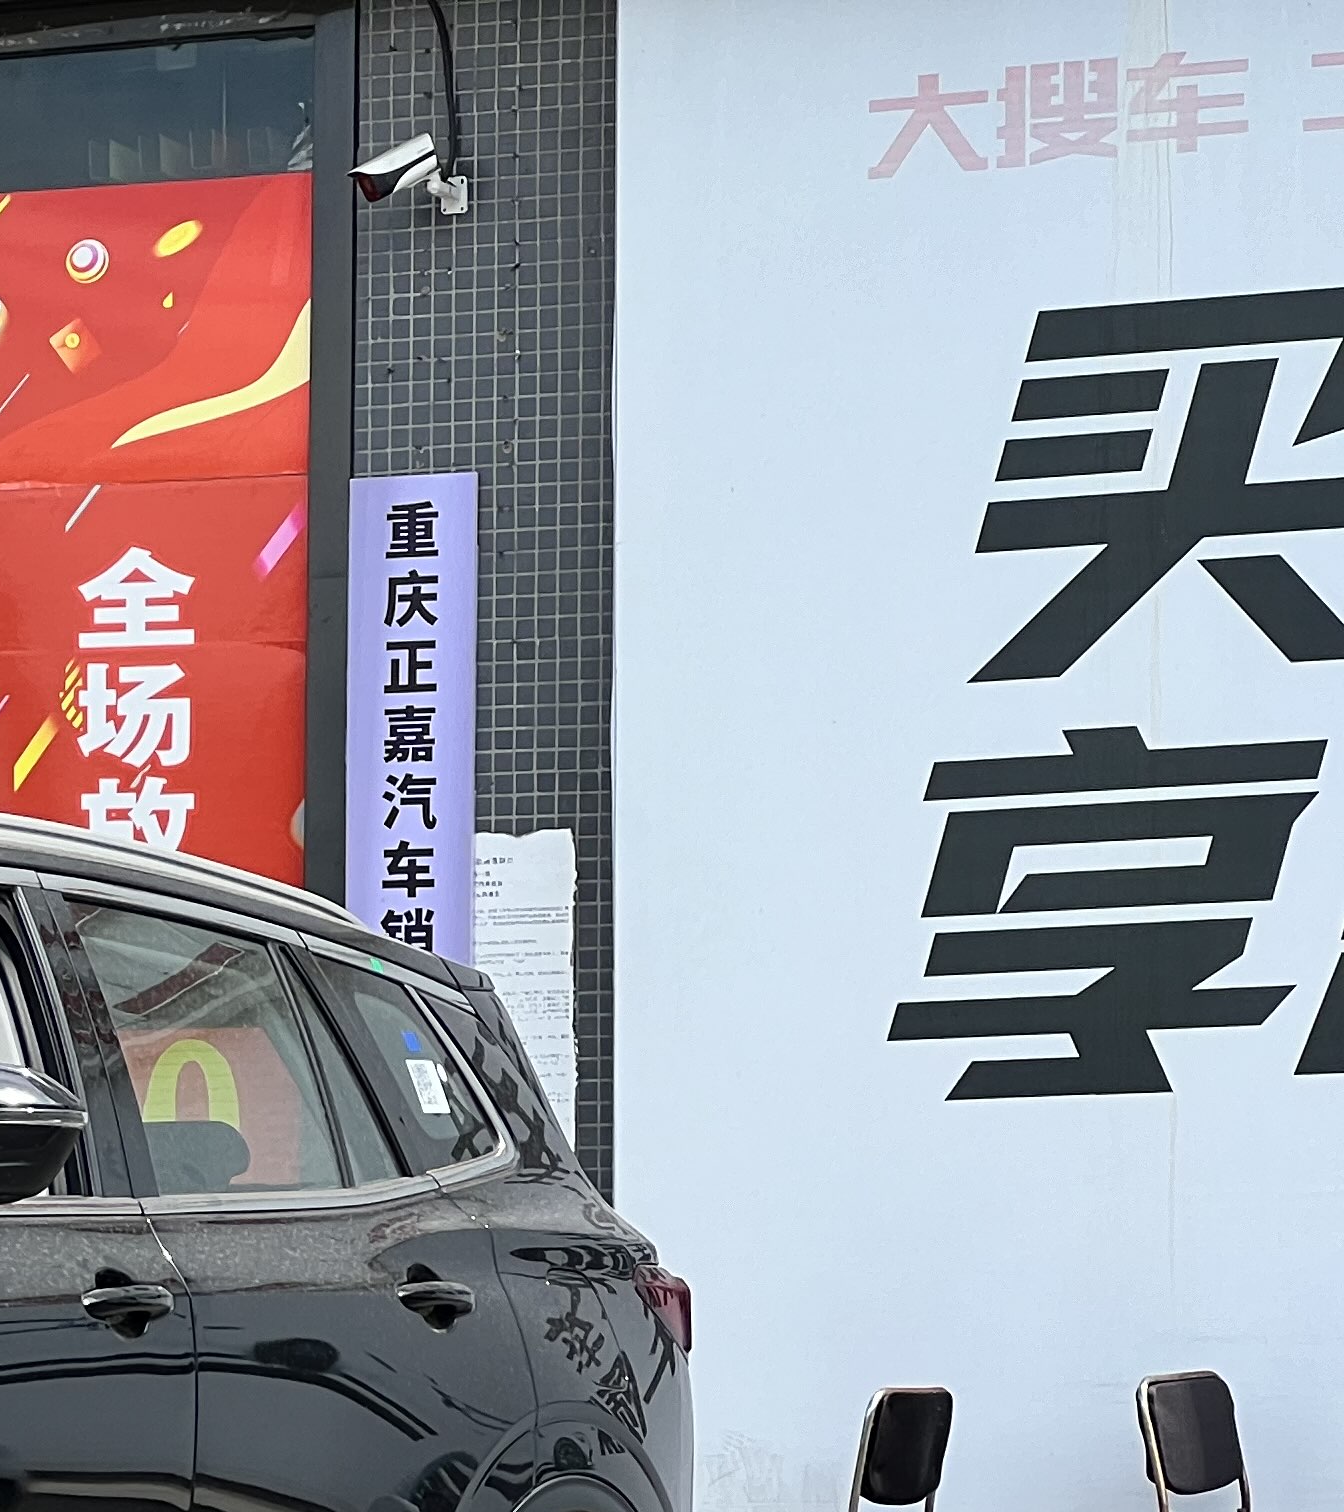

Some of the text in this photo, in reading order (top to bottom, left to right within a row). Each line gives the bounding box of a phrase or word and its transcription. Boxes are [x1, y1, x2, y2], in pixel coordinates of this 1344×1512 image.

[868, 51, 1249, 179] 大搜车
[381, 501, 440, 952] 重庆正嘉汽车销
[887, 726, 1344, 1101] 享
